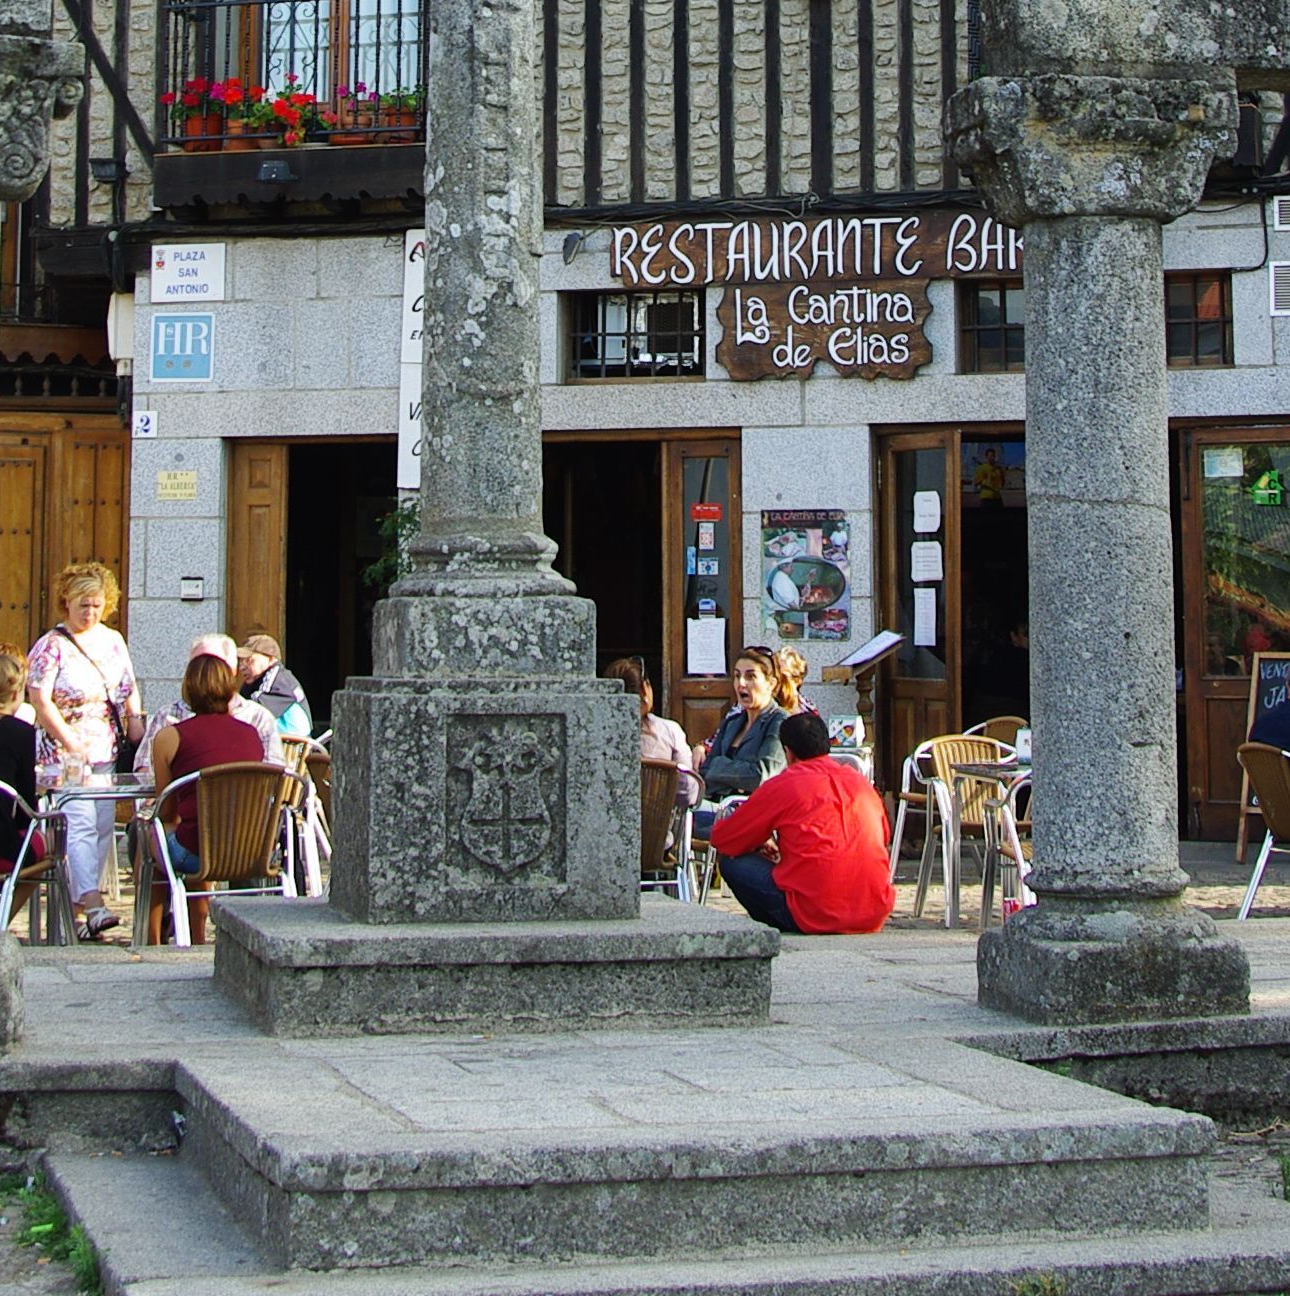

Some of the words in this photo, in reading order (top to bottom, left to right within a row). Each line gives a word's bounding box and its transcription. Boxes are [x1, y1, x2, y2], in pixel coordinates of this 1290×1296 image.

[173, 250, 206, 261] PLAZA
[612, 216, 923, 285] RESTAURANTE
[178, 268, 198, 278] SAN
[165, 283, 209, 295] ANTONIO
[735, 287, 770, 346] La
[787, 285, 915, 326] Cantina
[772, 326, 811, 368] de
[827, 326, 910, 366] Elias
[140, 415, 150, 433] 2
